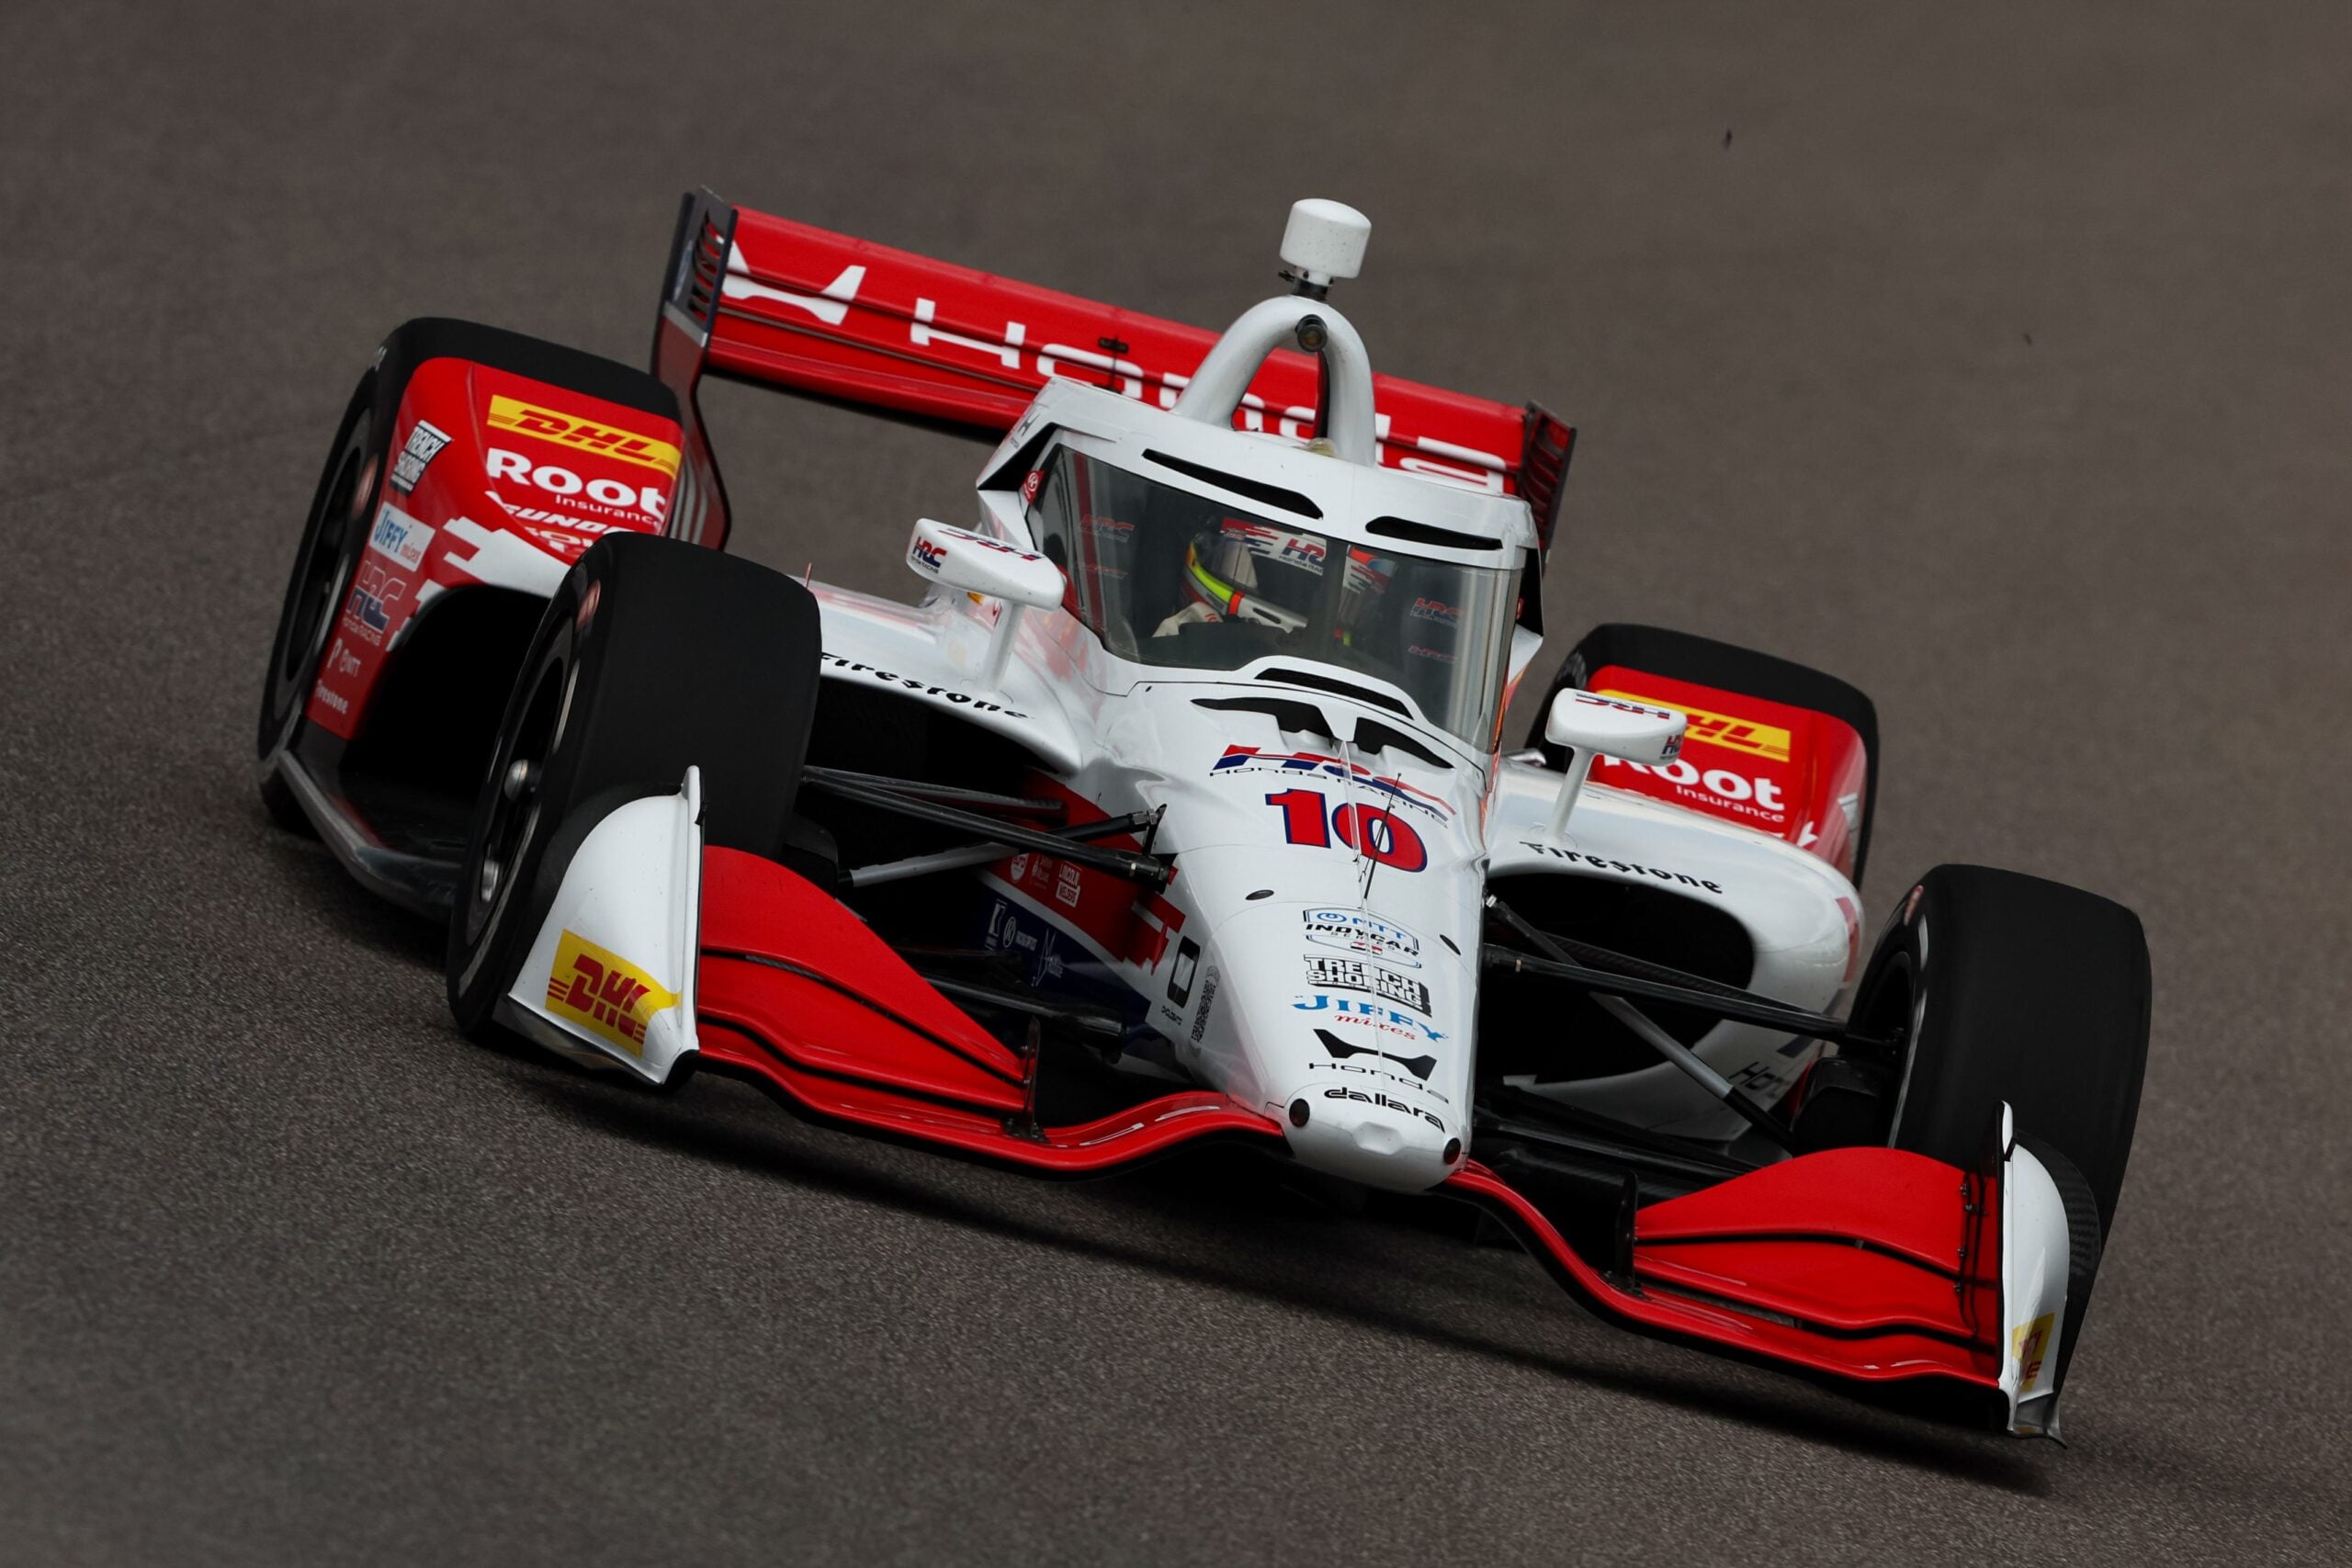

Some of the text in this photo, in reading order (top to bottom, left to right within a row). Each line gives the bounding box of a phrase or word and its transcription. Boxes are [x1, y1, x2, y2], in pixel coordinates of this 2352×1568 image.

[514, 410, 658, 462] DHL
[912, 536, 947, 569] HRC
[1685, 713, 1763, 750] HL
[1677, 784, 1785, 823] Insurance
[1265, 788, 1429, 873] 10
[1519, 840, 1723, 894] Firestone
[1306, 923, 1419, 957] INDYCAR
[1351, 917, 1407, 940] NTT
[565, 953, 650, 1039] DHL
[1304, 954, 1421, 997] TRENCH
[1306, 969, 1423, 1008] SHORING
[1334, 1013, 1416, 1041] mixes
[1309, 1062, 1450, 1105] Honda
[1324, 1087, 1446, 1134] dallara
